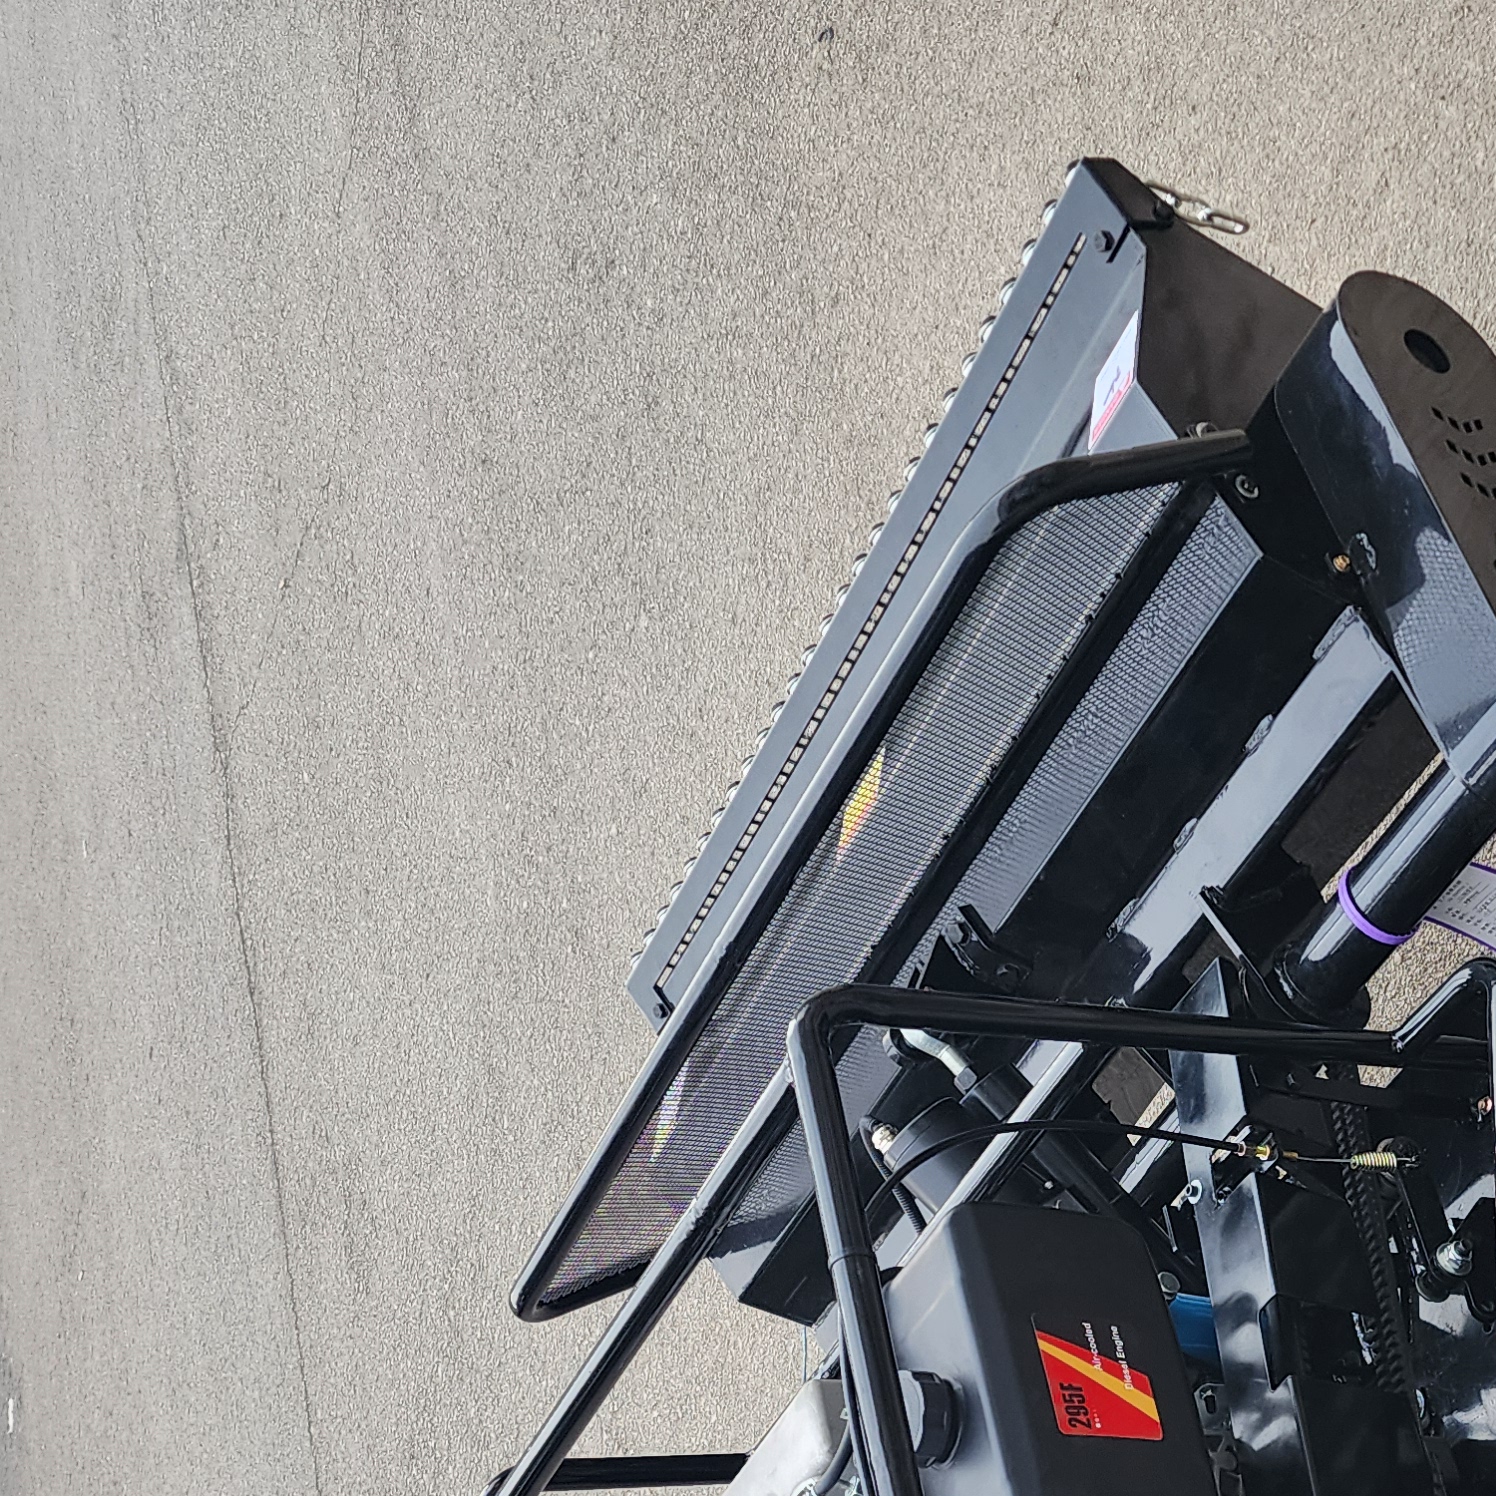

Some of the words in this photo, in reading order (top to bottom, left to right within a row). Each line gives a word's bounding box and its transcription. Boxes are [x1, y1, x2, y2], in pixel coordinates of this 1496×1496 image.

[1082, 1322, 1102, 1371] Air-cooled
[1111, 1326, 1125, 1359] Engine
[1119, 1361, 1133, 1390] Diesel
[1060, 1383, 1091, 1429] 295F
